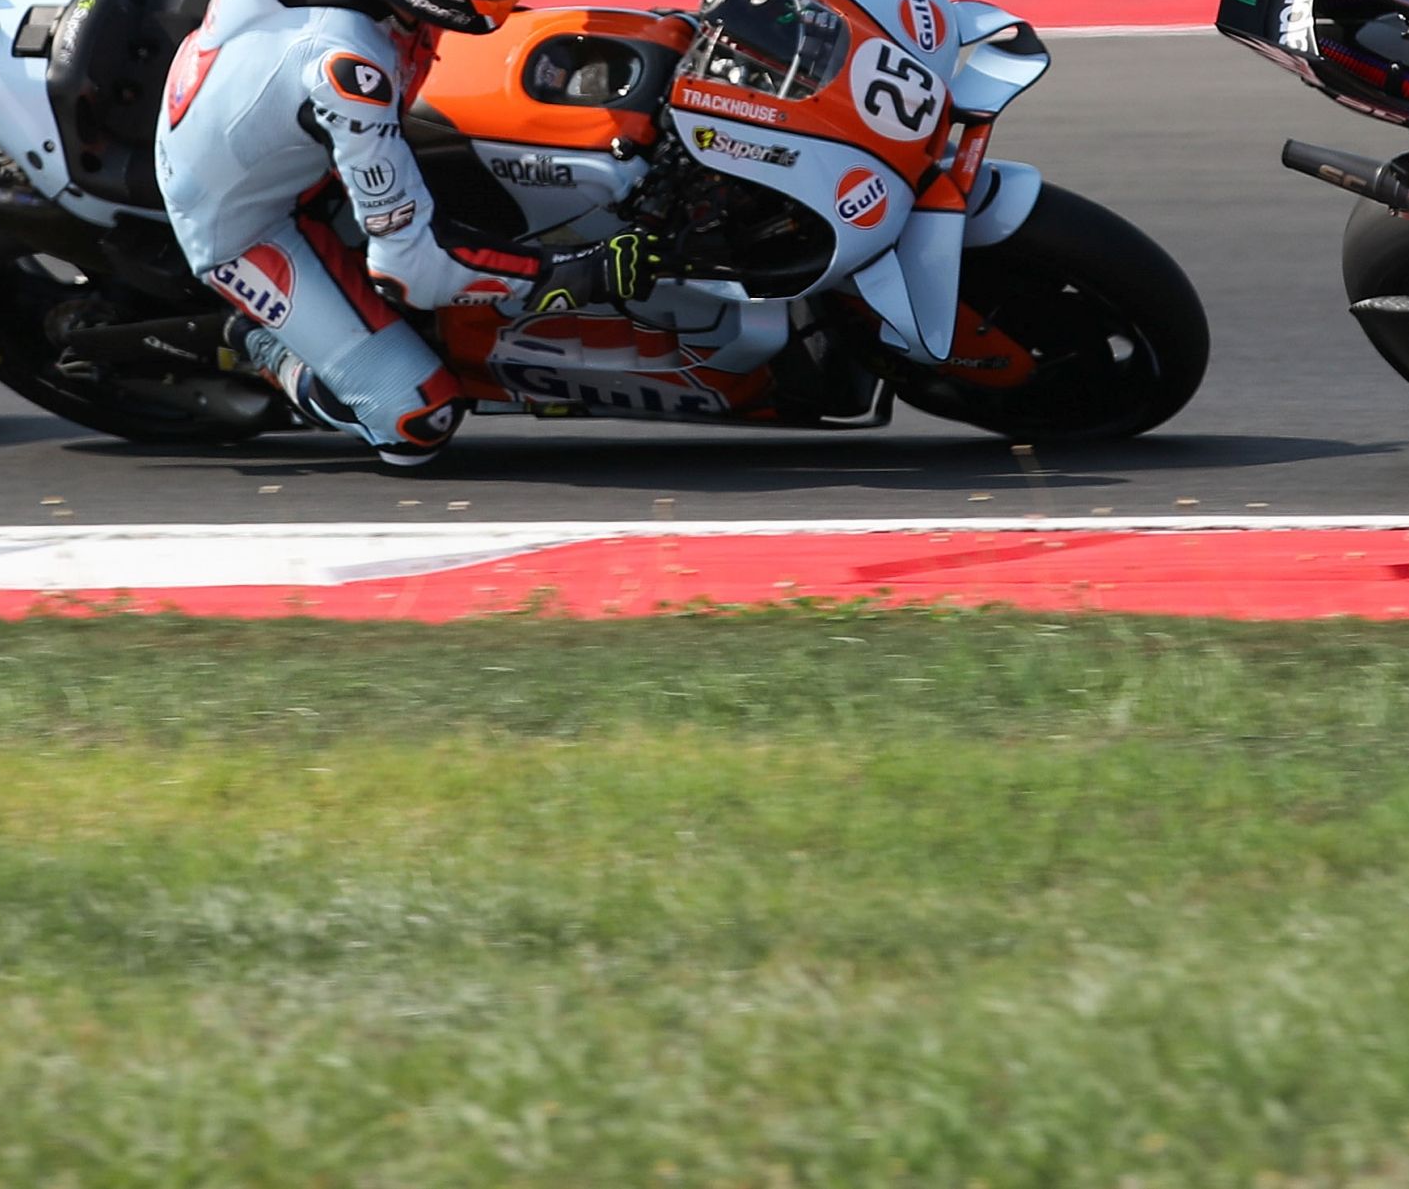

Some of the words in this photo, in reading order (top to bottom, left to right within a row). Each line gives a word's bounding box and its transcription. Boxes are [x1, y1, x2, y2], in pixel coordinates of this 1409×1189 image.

[682, 88, 779, 123] TRACKHOUSE
[864, 43, 937, 132] 25
[492, 155, 573, 185] aprilia
[836, 178, 887, 220] Gulf
[214, 260, 287, 323] Gulf
